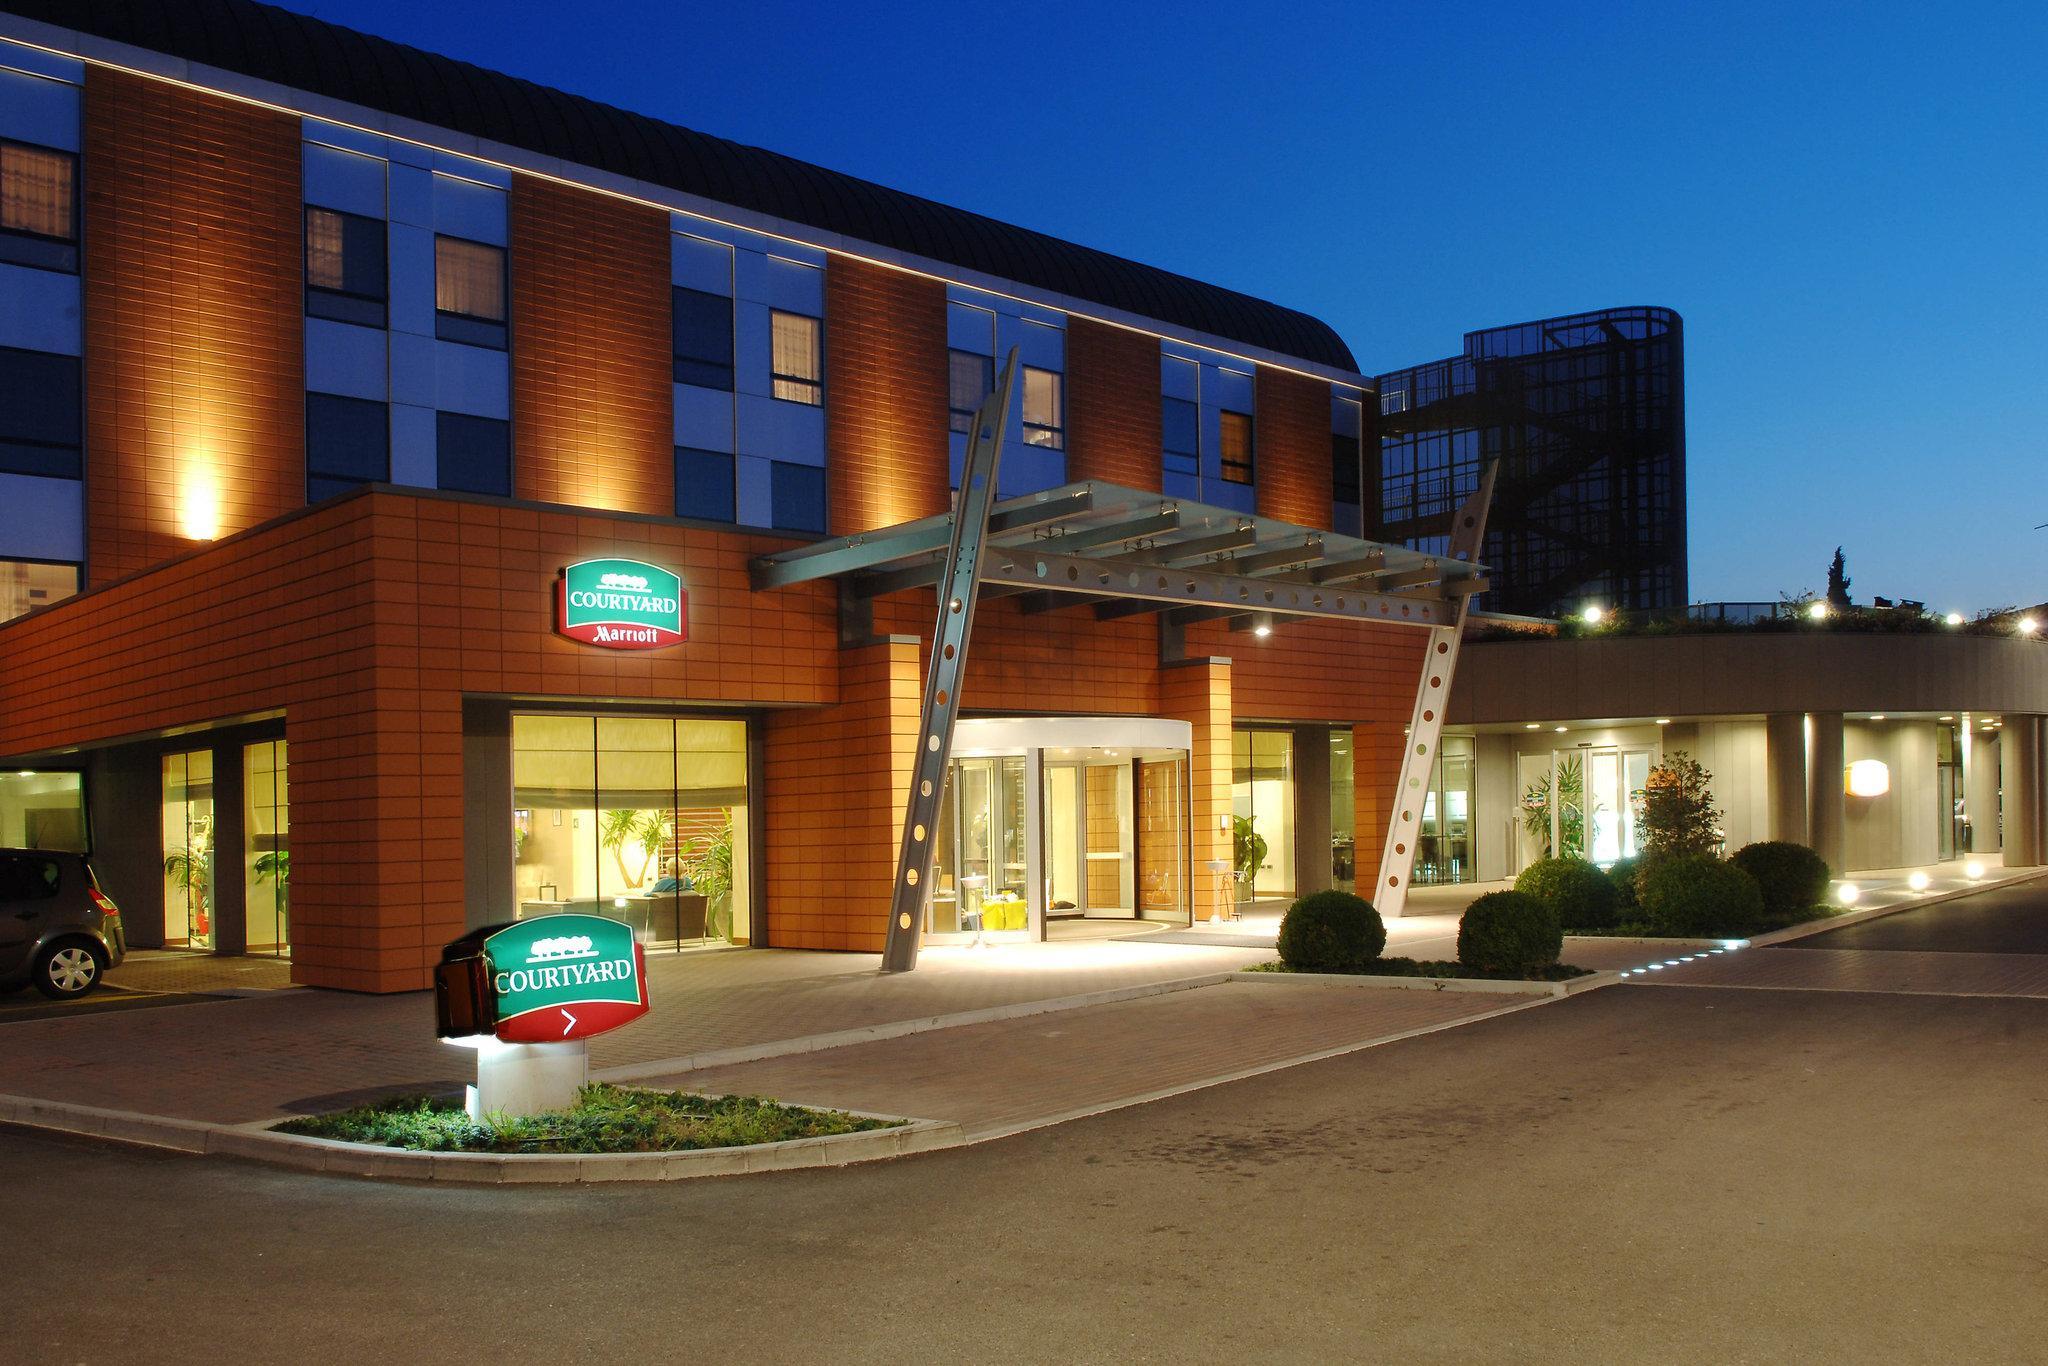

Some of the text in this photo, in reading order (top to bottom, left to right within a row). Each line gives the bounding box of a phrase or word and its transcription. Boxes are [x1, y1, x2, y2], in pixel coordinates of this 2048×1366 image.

[570, 591, 677, 613] COURTYARD
[593, 625, 658, 643] Marriott
[495, 959, 632, 994] COURTYARD
